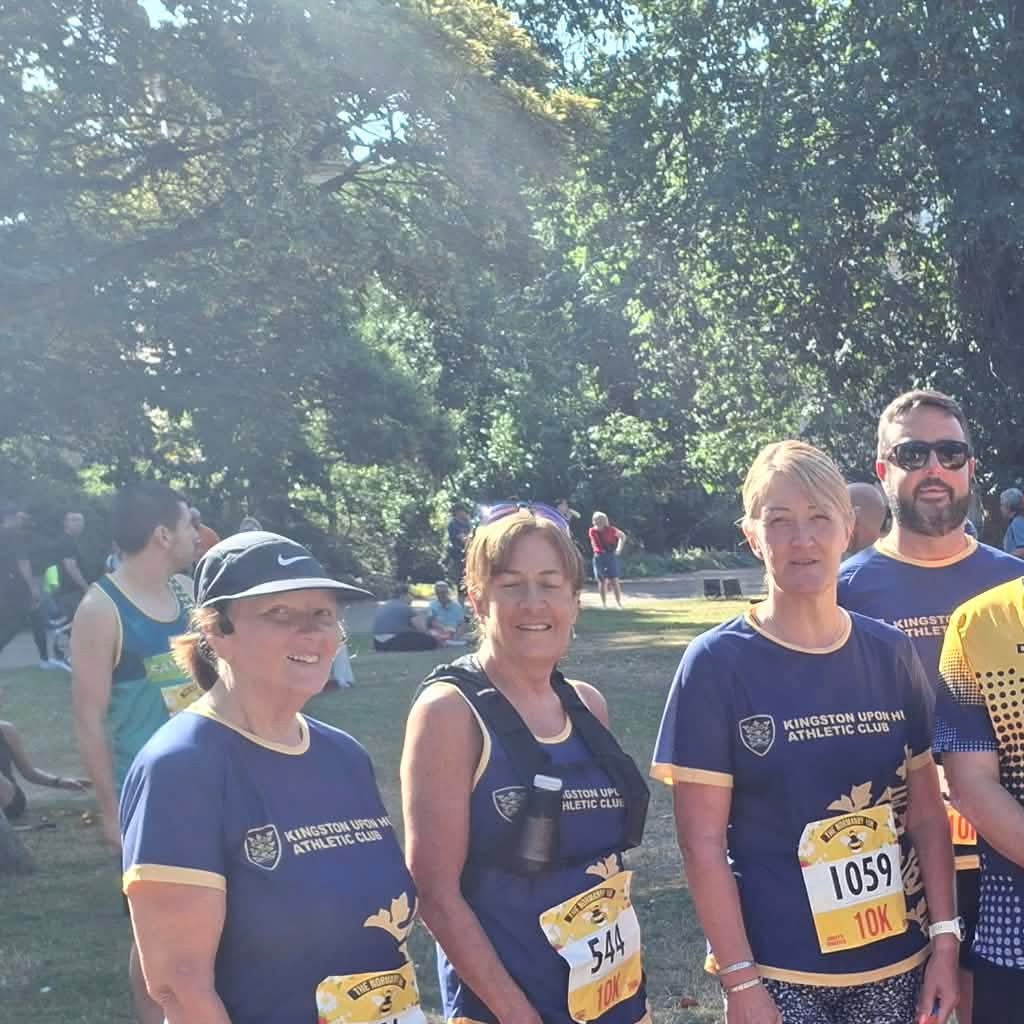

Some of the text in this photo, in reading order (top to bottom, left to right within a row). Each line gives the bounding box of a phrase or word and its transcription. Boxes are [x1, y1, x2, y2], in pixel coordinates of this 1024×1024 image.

[894, 616, 951, 628] KINGST
[904, 626, 945, 638] THLET
[784, 712, 855, 730] KINGSTON
[858, 711, 889, 722] UPON
[788, 722, 889, 741] ATHLETIC CLUB
[563, 788, 598, 799] GSTON
[562, 800, 598, 811] HLETIC
[284, 821, 351, 842] KINGSTON
[349, 816, 377, 831] UPON
[292, 829, 383, 855] ATHLETIC CLUB
[829, 853, 892, 900] 1059
[854, 903, 893, 940] 10K
[588, 924, 625, 975] 544
[597, 973, 621, 1010] 10K
